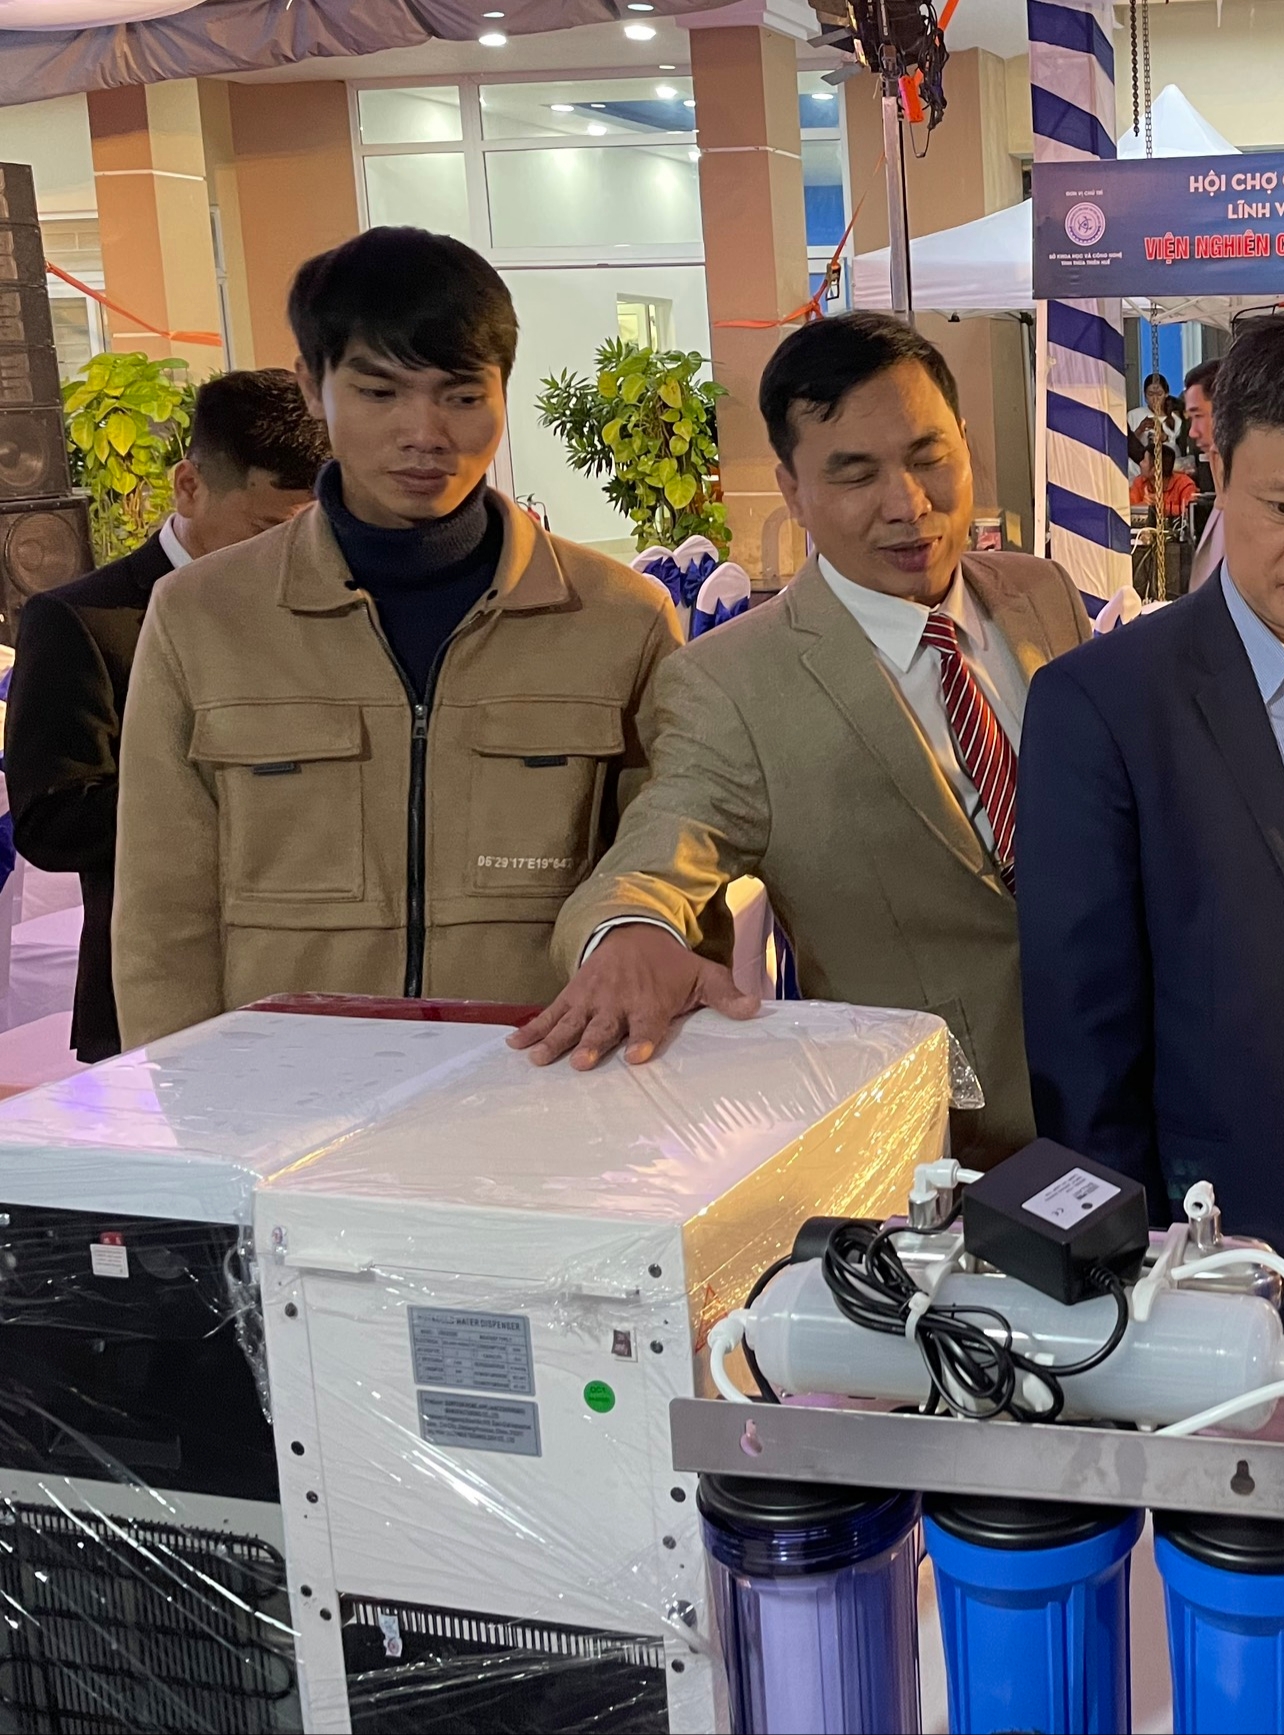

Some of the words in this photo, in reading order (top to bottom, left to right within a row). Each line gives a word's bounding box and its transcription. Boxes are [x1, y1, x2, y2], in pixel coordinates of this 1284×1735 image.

[1189, 170, 1226, 197] HỘI
[1231, 171, 1278, 195] CHỢ
[1228, 197, 1270, 220] LĨNH
[1144, 231, 1190, 265] VIỆN
[1195, 229, 1270, 259] NGHIÊN
